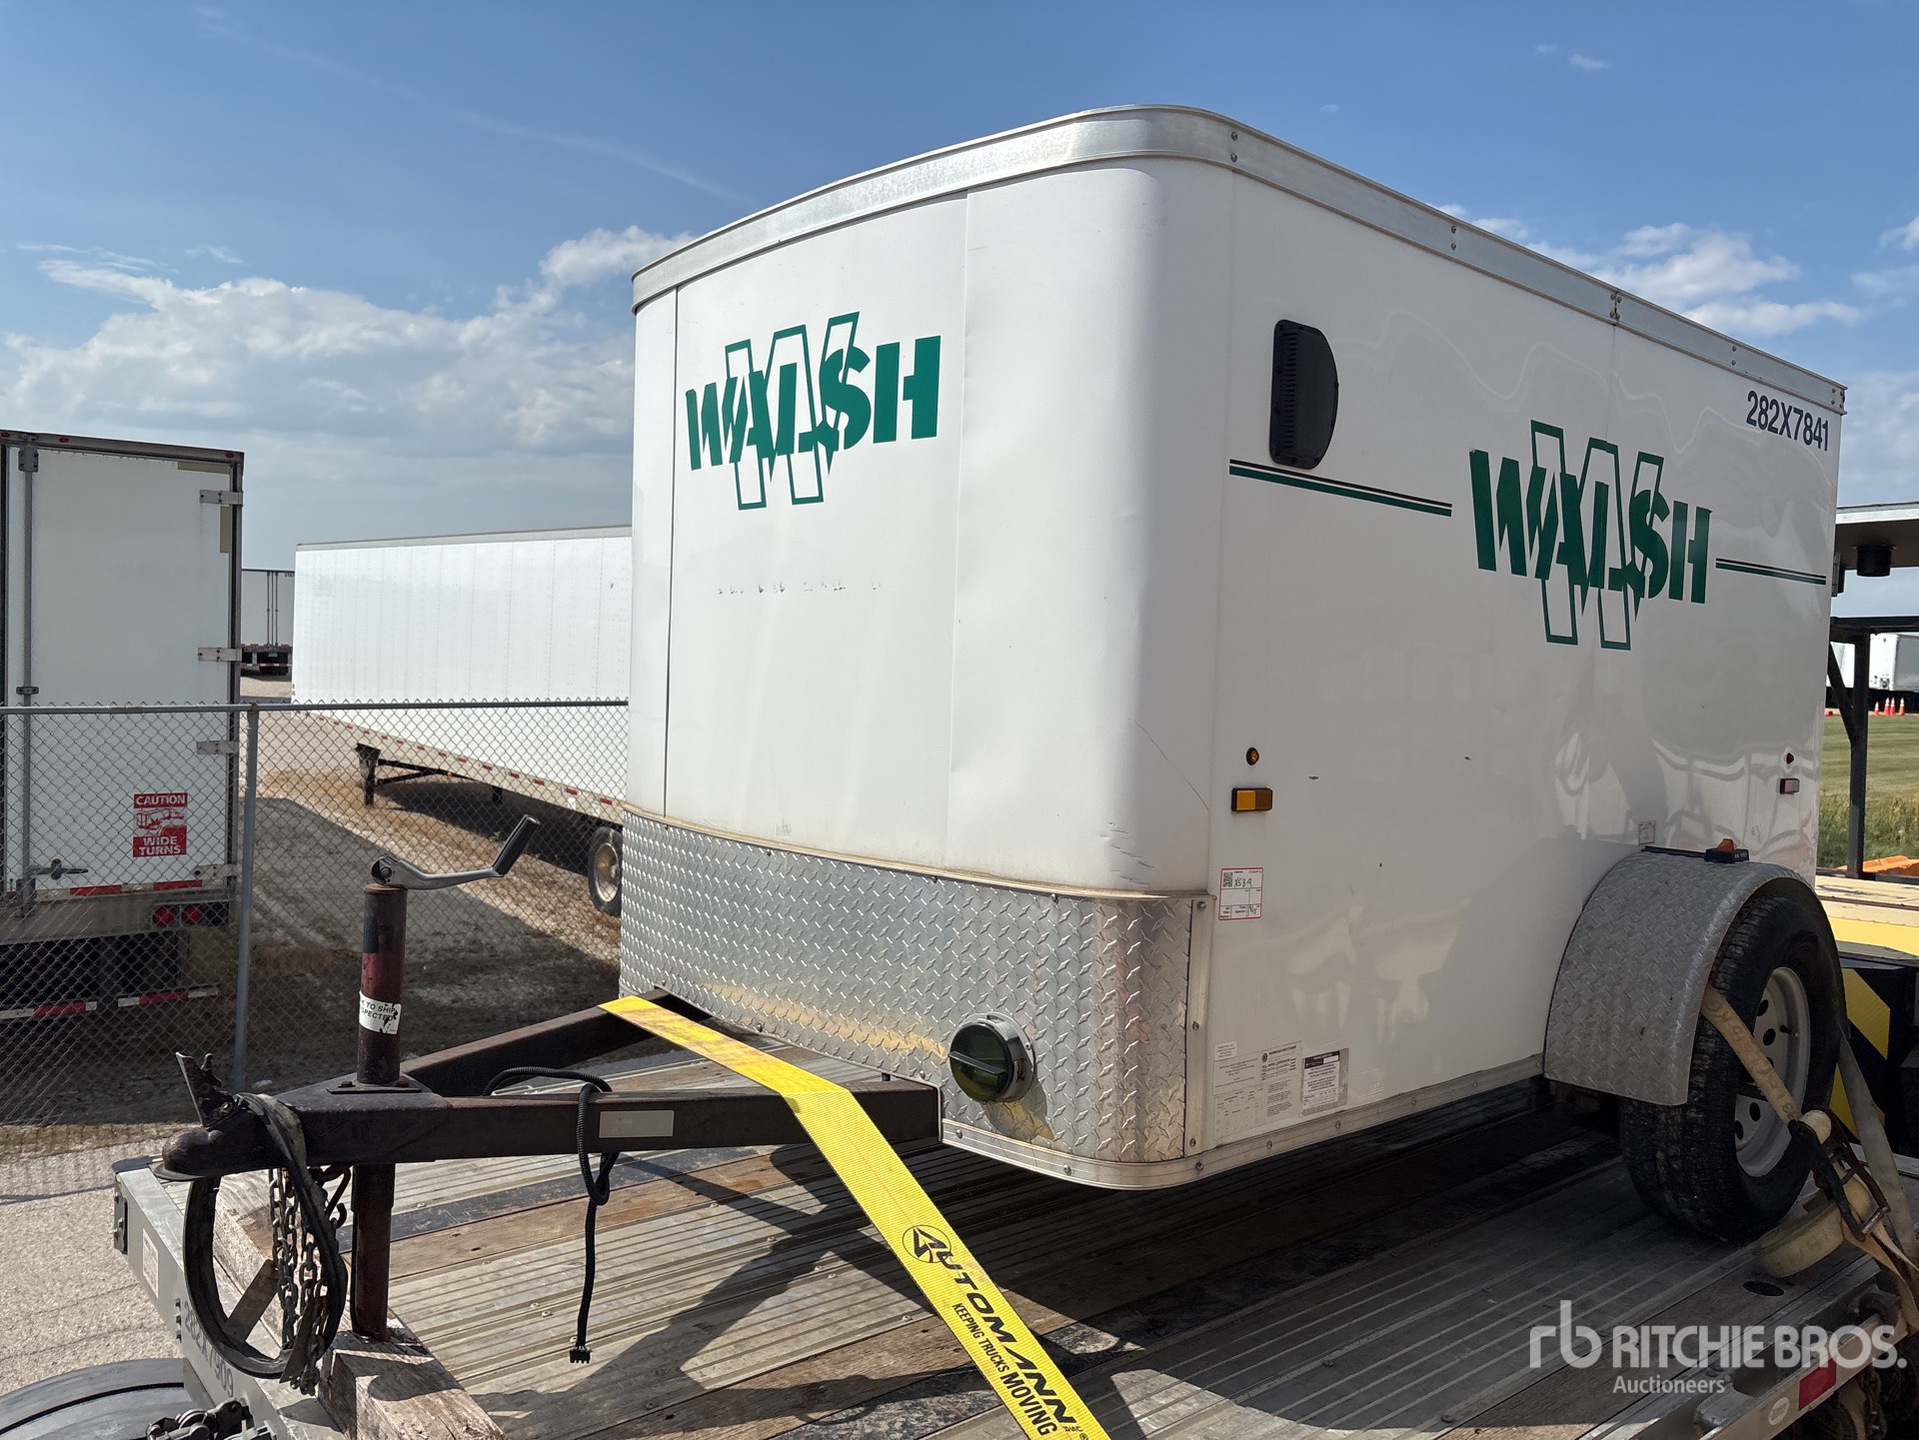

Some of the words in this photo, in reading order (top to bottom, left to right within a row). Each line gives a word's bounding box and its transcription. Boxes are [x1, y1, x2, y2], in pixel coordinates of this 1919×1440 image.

[685, 334, 942, 472] WALSH
[1746, 390, 1829, 452] 282X7841
[1469, 448, 1713, 605] WALSH
[136, 795, 186, 805] CAUTION
[139, 845, 181, 855] TURNS
[143, 836, 177, 846] WIDE
[367, 1002, 376, 1010] TO
[378, 1005, 396, 1014] SHIP
[912, 1226, 1078, 1423] AUTOMANN
[952, 1303, 985, 1340] KEEPING
[978, 1337, 1010, 1374] TRUCKS
[1000, 1371, 1058, 1436] MOVING
